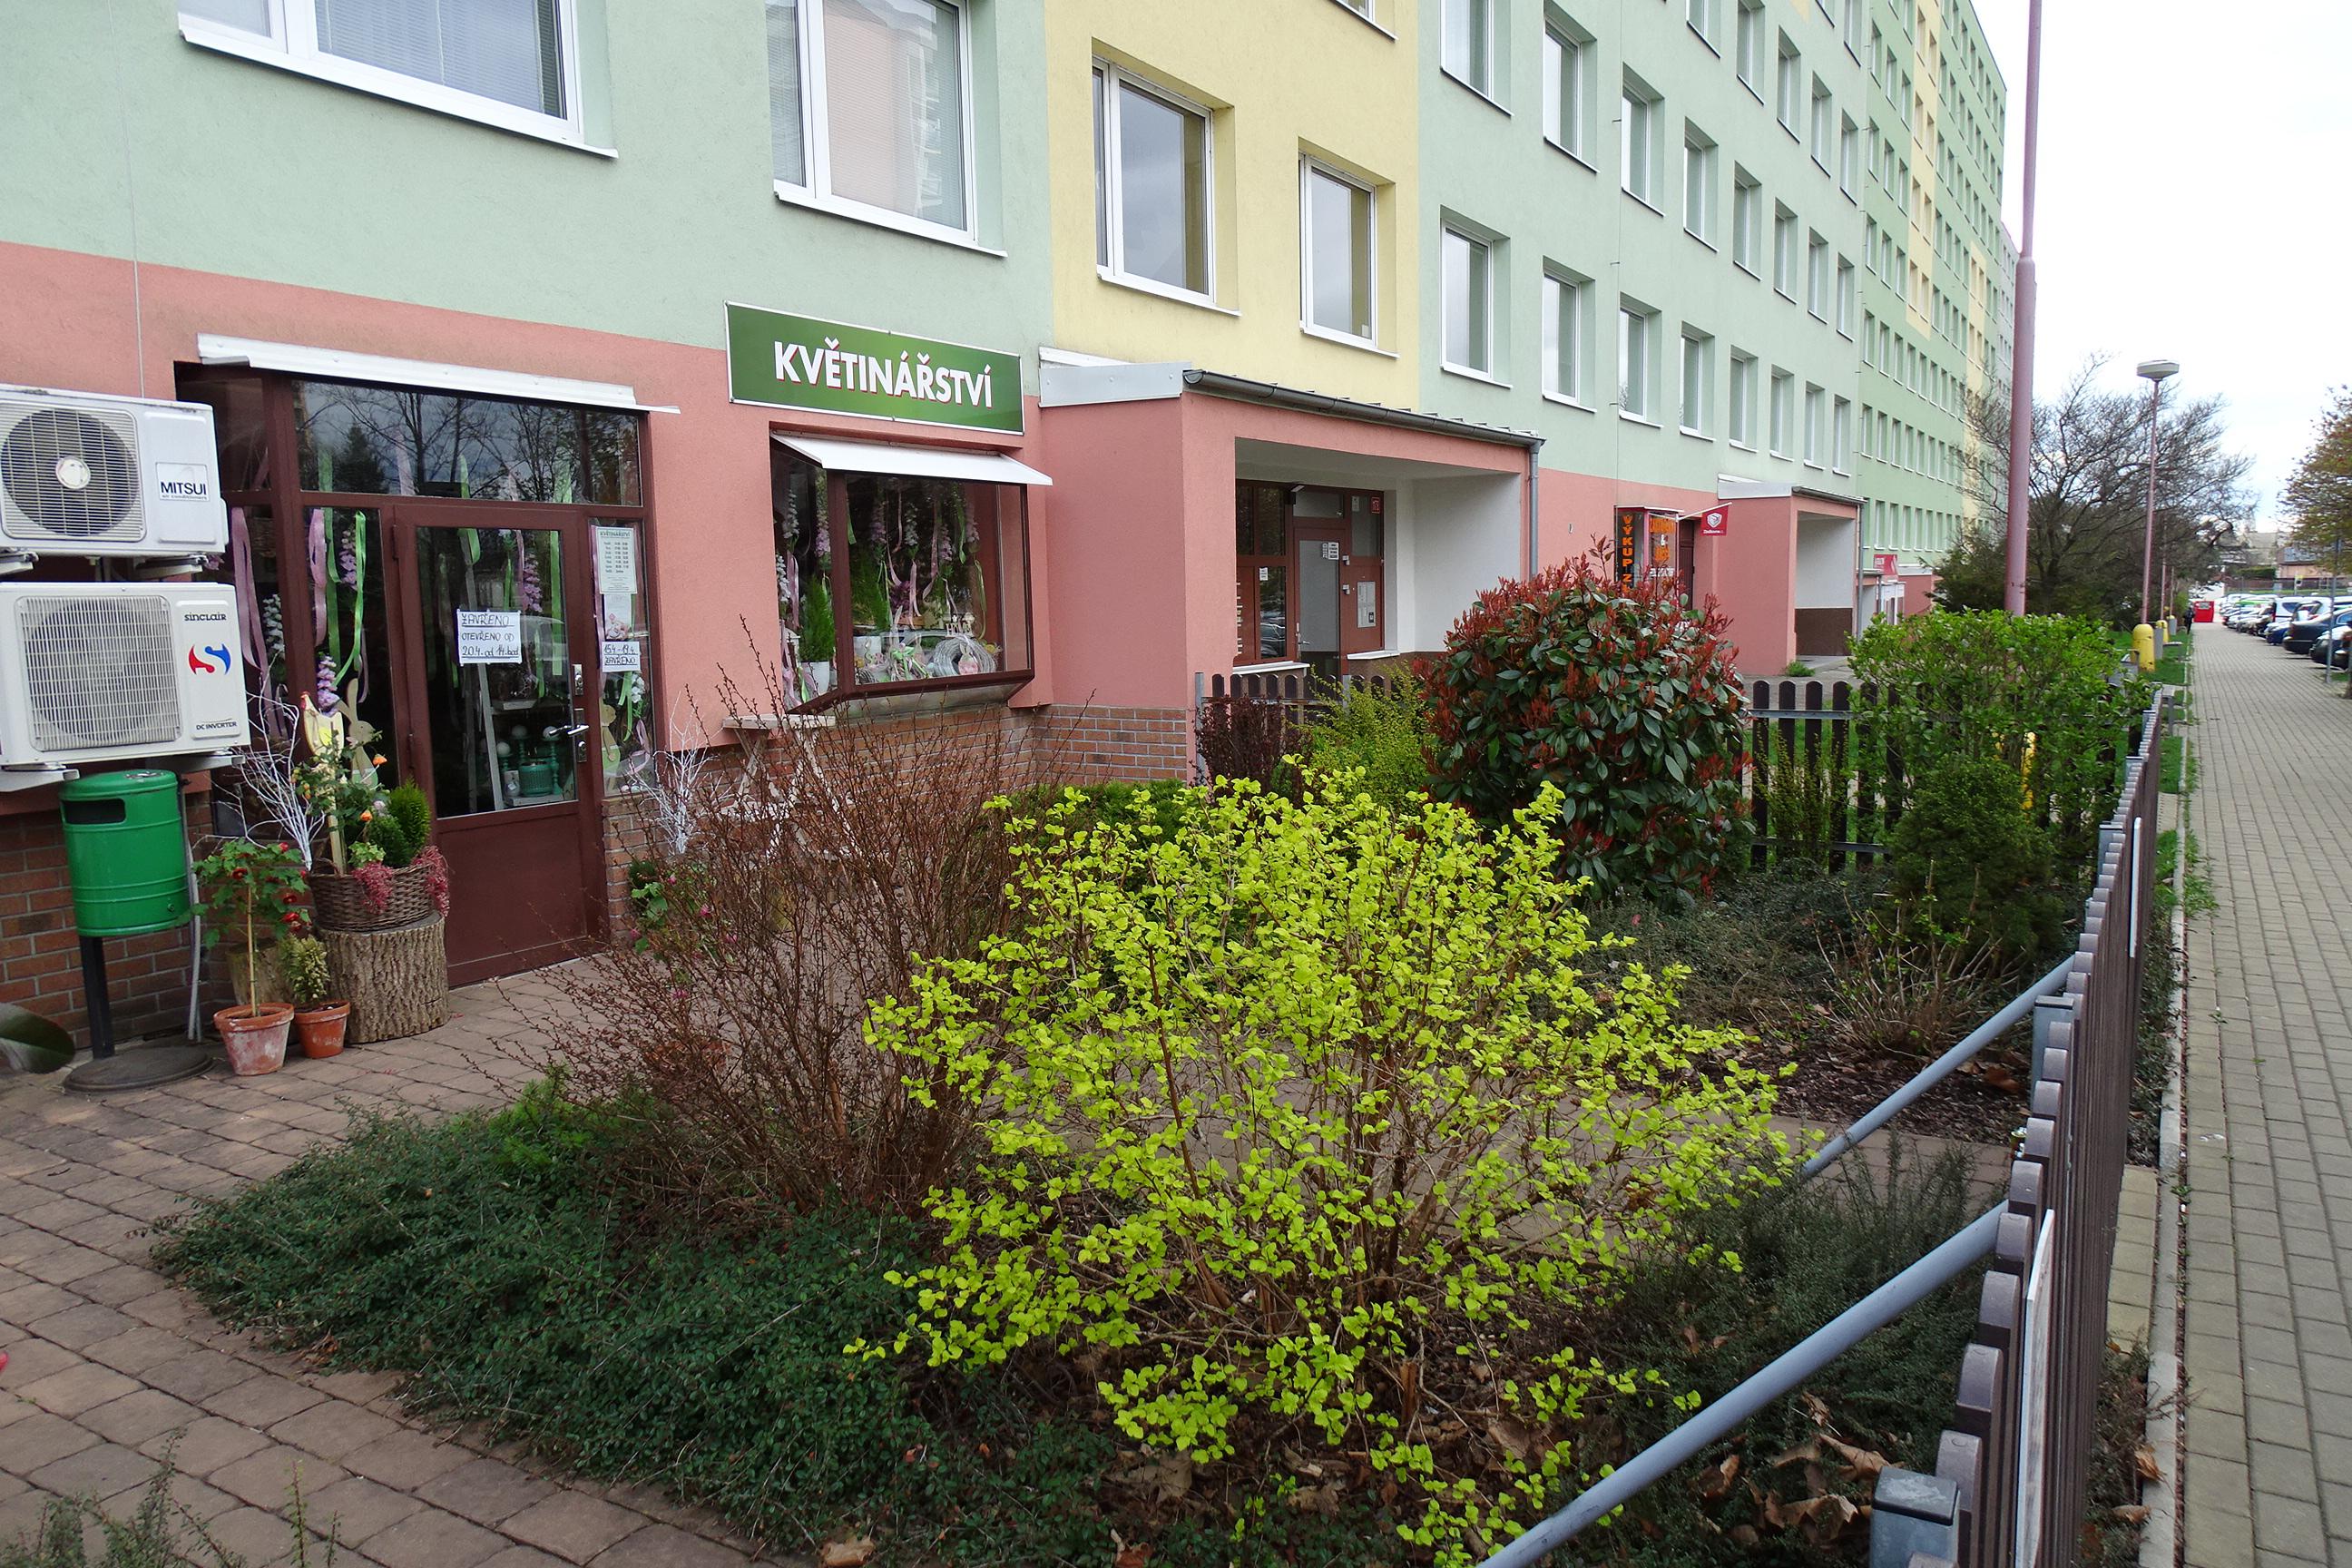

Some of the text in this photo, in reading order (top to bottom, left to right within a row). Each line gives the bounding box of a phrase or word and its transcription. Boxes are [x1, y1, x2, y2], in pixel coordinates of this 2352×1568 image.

[774, 336, 993, 408] KVĚTINÁŘSTVÍ
[161, 481, 207, 495] MITSUI
[1622, 514, 1633, 567] VÝKUP
[461, 631, 514, 642] OTEVŘENO OD
[206, 721, 238, 730] INVERTER
